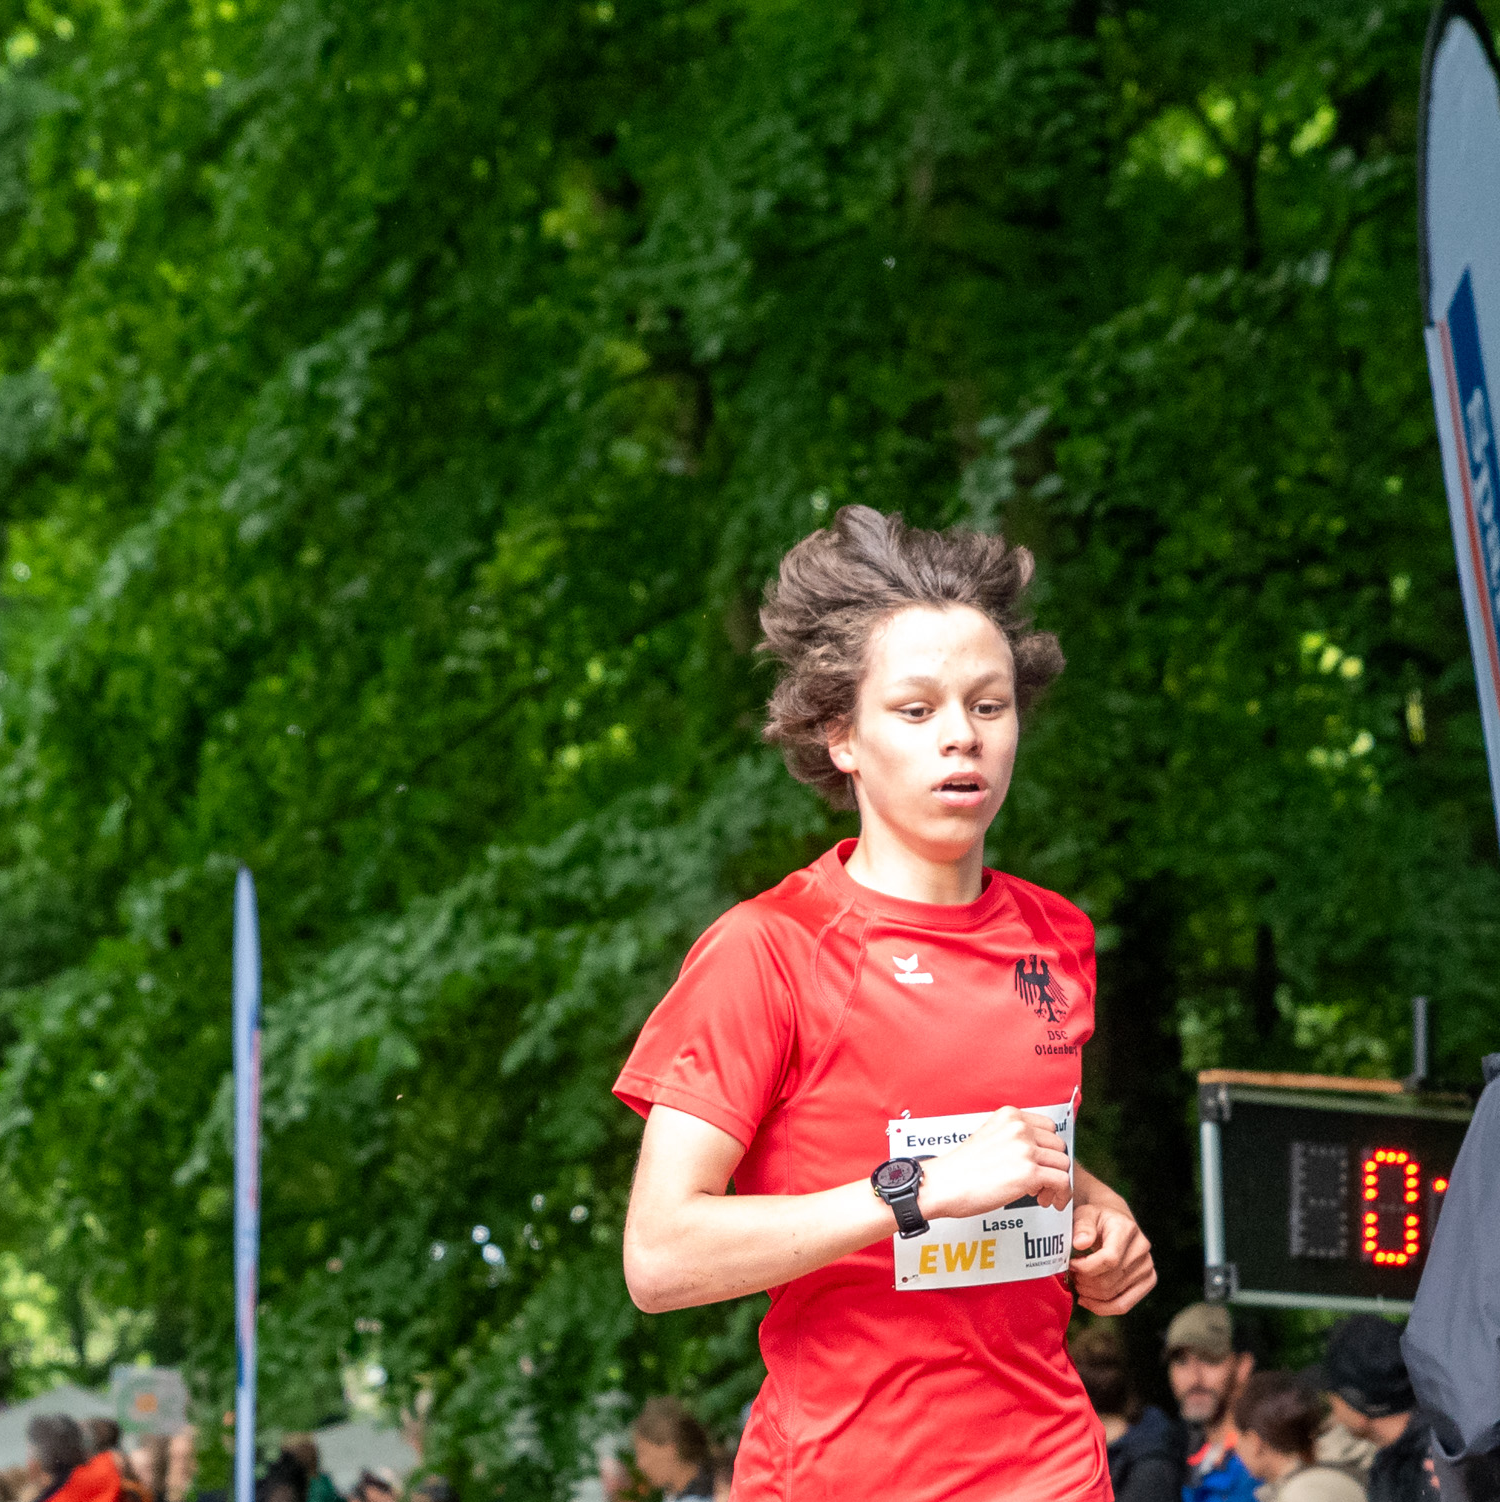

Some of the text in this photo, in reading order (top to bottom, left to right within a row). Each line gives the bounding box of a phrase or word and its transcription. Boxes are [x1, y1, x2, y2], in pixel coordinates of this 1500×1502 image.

[1047, 1030, 1068, 1041] DSC
[982, 1218, 1024, 1233] Lasse
[918, 1231, 1065, 1275] EWE bruns
